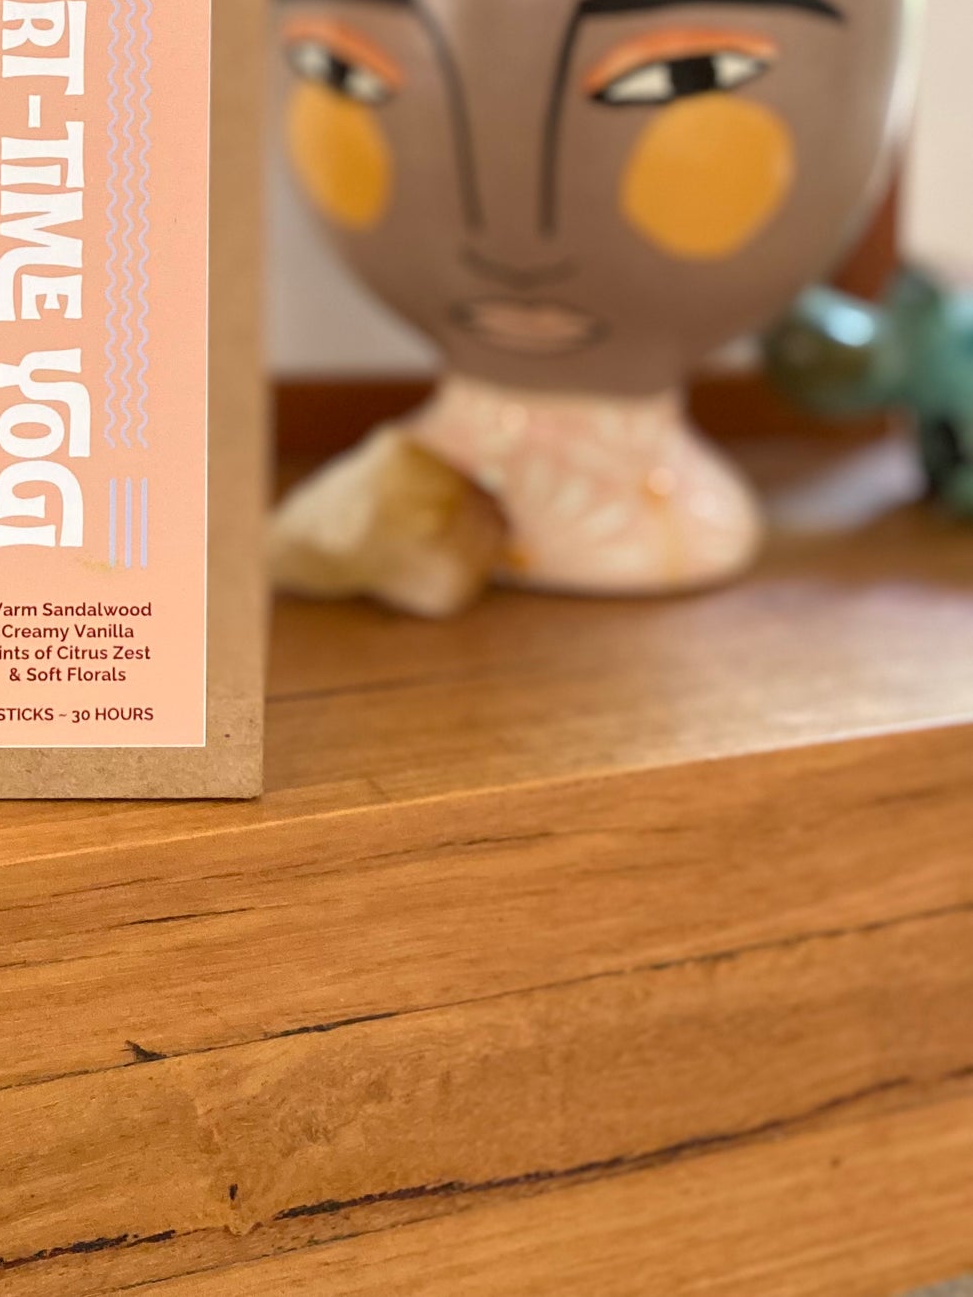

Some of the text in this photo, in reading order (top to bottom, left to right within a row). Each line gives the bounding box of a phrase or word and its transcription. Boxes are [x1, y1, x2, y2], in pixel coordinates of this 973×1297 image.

[42, 602, 152, 617] Sandalwood
[1, 624, 134, 642] Creamy Vanilla
[34, 645, 52, 660] of
[57, 645, 108, 660] Citrus
[113, 646, 150, 660] Zest
[9, 667, 126, 682] & Soft Florals
[71, 710, 90, 723] 30
[95, 708, 154, 721] HOURS
